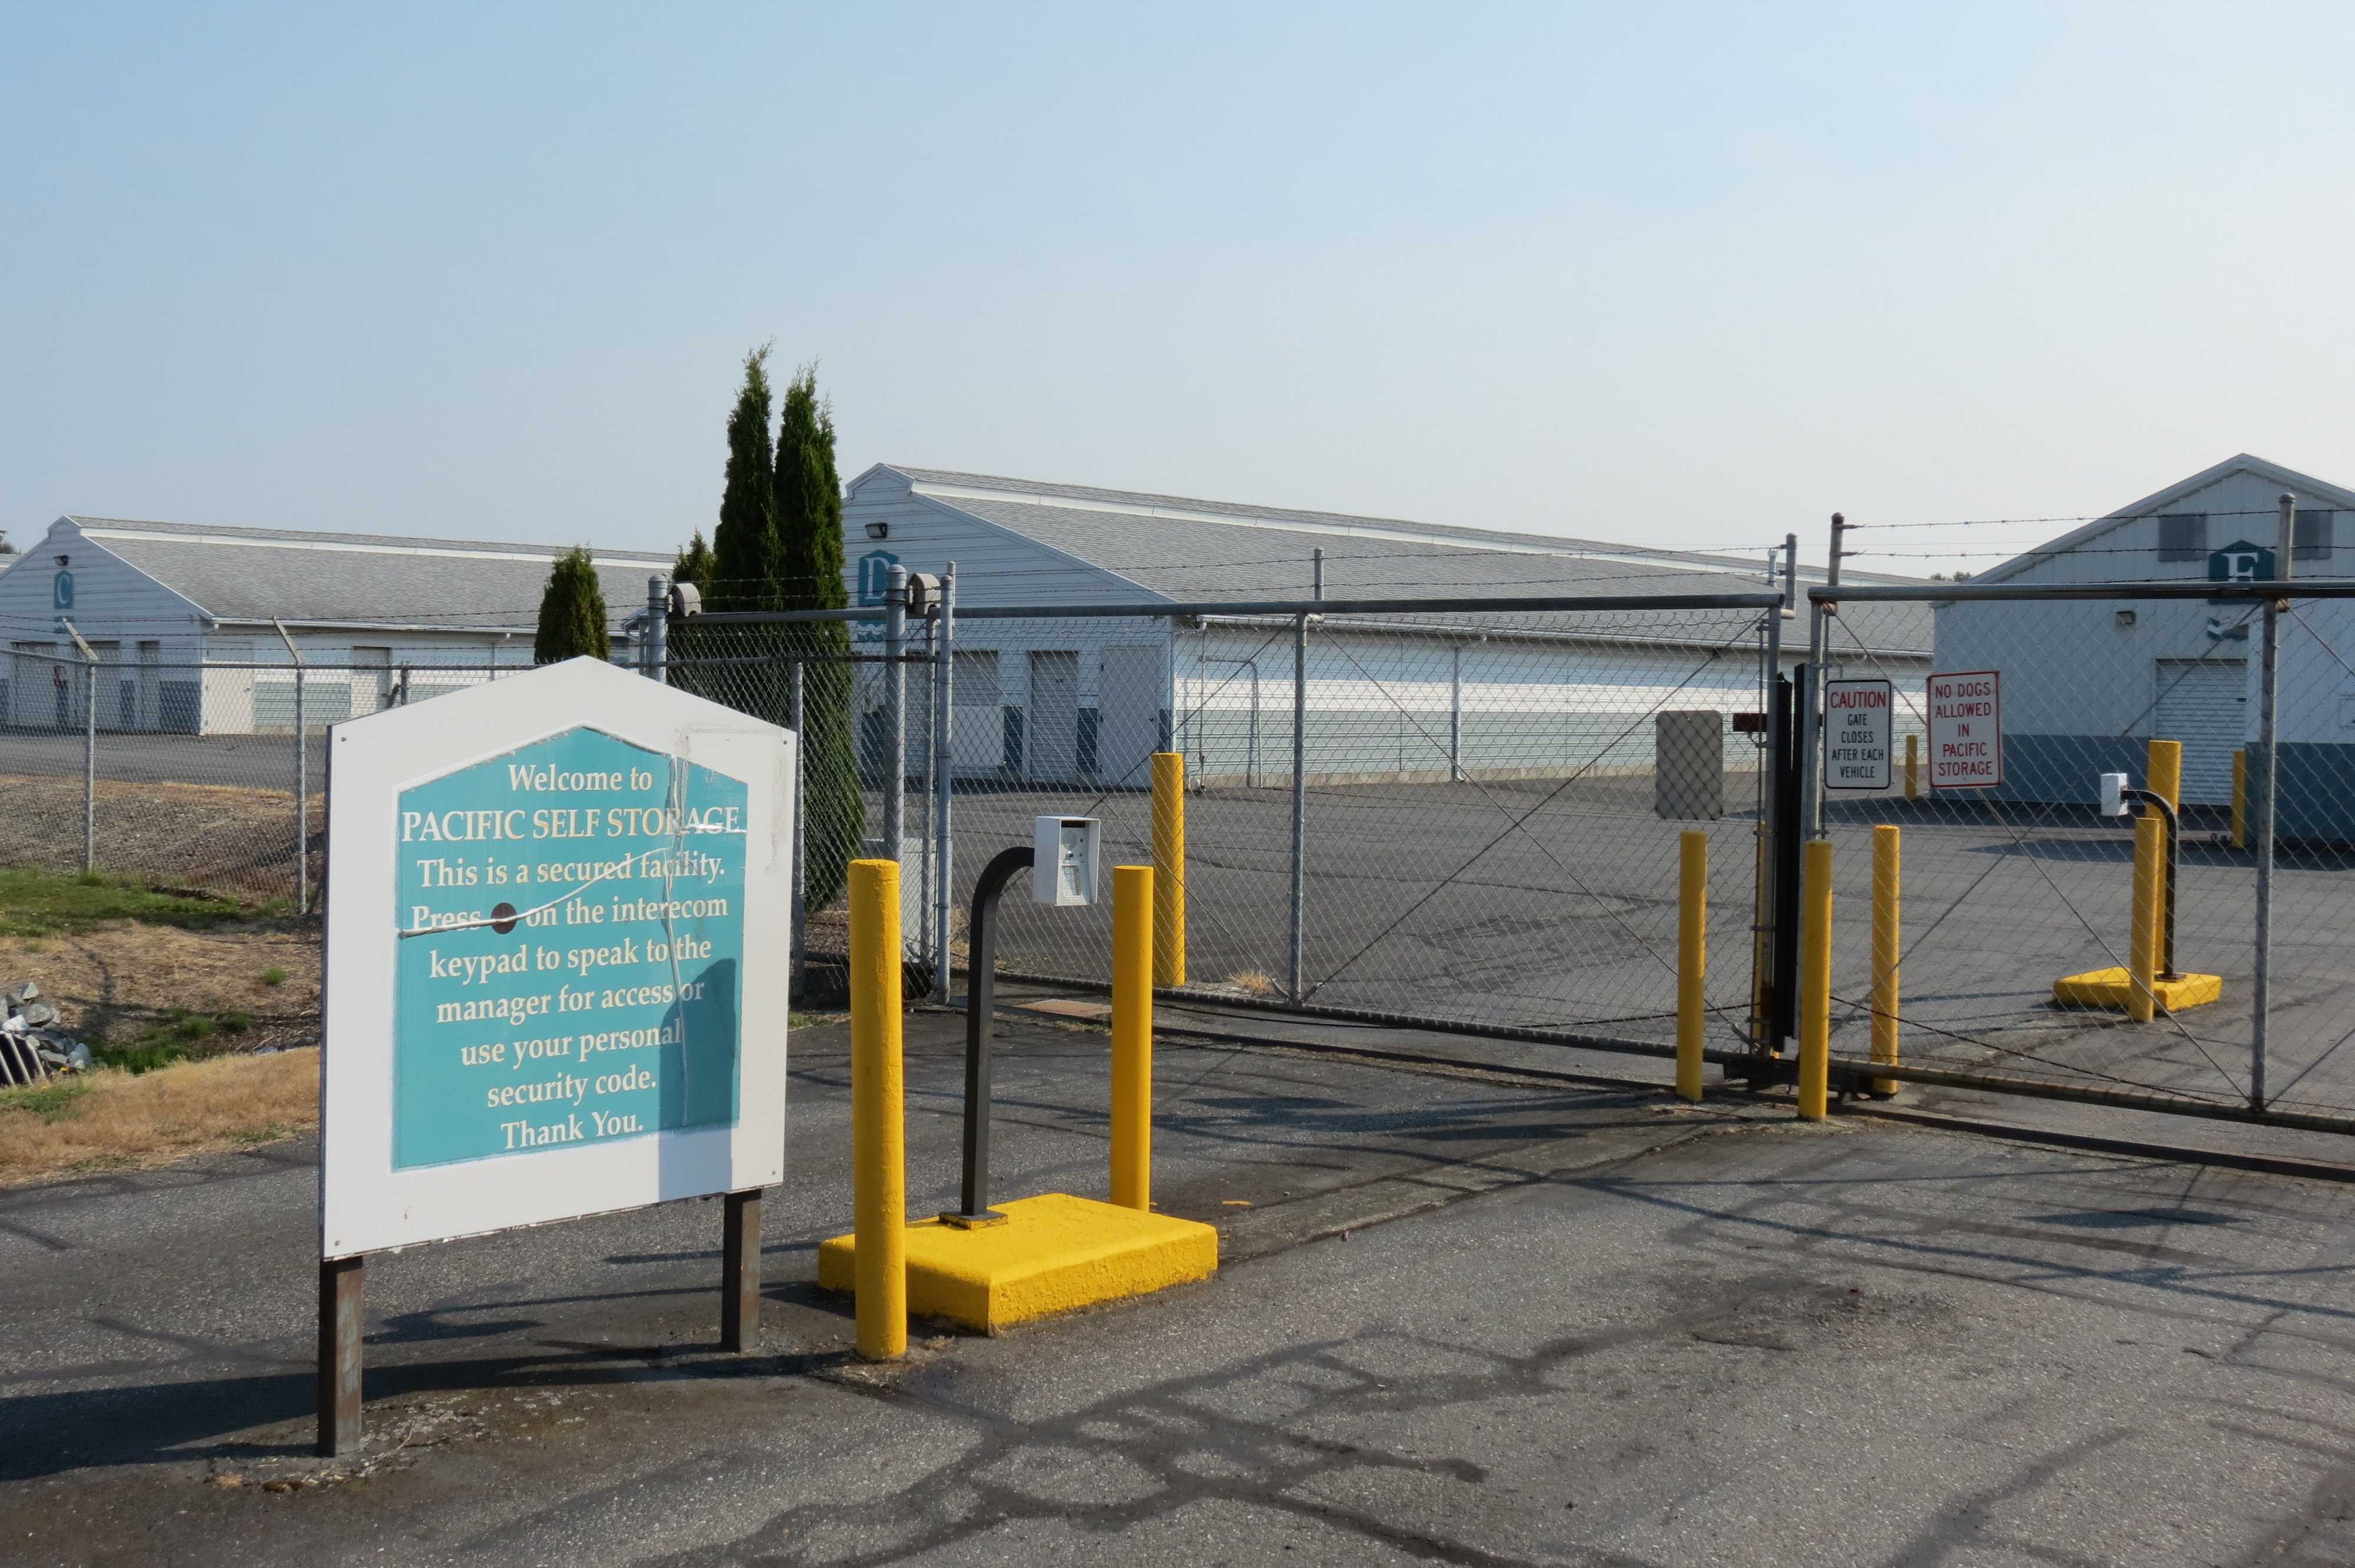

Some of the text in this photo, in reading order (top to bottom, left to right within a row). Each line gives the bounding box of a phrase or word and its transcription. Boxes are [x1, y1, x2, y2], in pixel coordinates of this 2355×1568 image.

[58, 574, 70, 604] C
[1830, 691, 1886, 708] CAUTION
[1935, 682, 1991, 699] NO DOGS
[1847, 713, 1868, 726] GATE
[1935, 702, 1991, 718] ALLOWED
[1841, 731, 1873, 743] CLOSES
[1958, 723, 1969, 737] IN
[1832, 748, 1883, 761] AFTER EACH
[1943, 742, 1987, 758] PACIFIC
[508, 764, 653, 792] Welcome to
[1840, 766, 1875, 779] VEHICLE
[1938, 761, 1992, 776] STORAGE
[402, 806, 740, 842] PACIFIC SELF STORAGE
[417, 851, 725, 888] This is a secured facility.
[412, 895, 728, 931] Press on the interecom
[429, 934, 712, 985] keypad to speak to the
[436, 982, 705, 1026] manager for access or
[460, 1018, 682, 1069] use your personal
[487, 1064, 657, 1107] security code.
[501, 1109, 644, 1150] Thank You.
